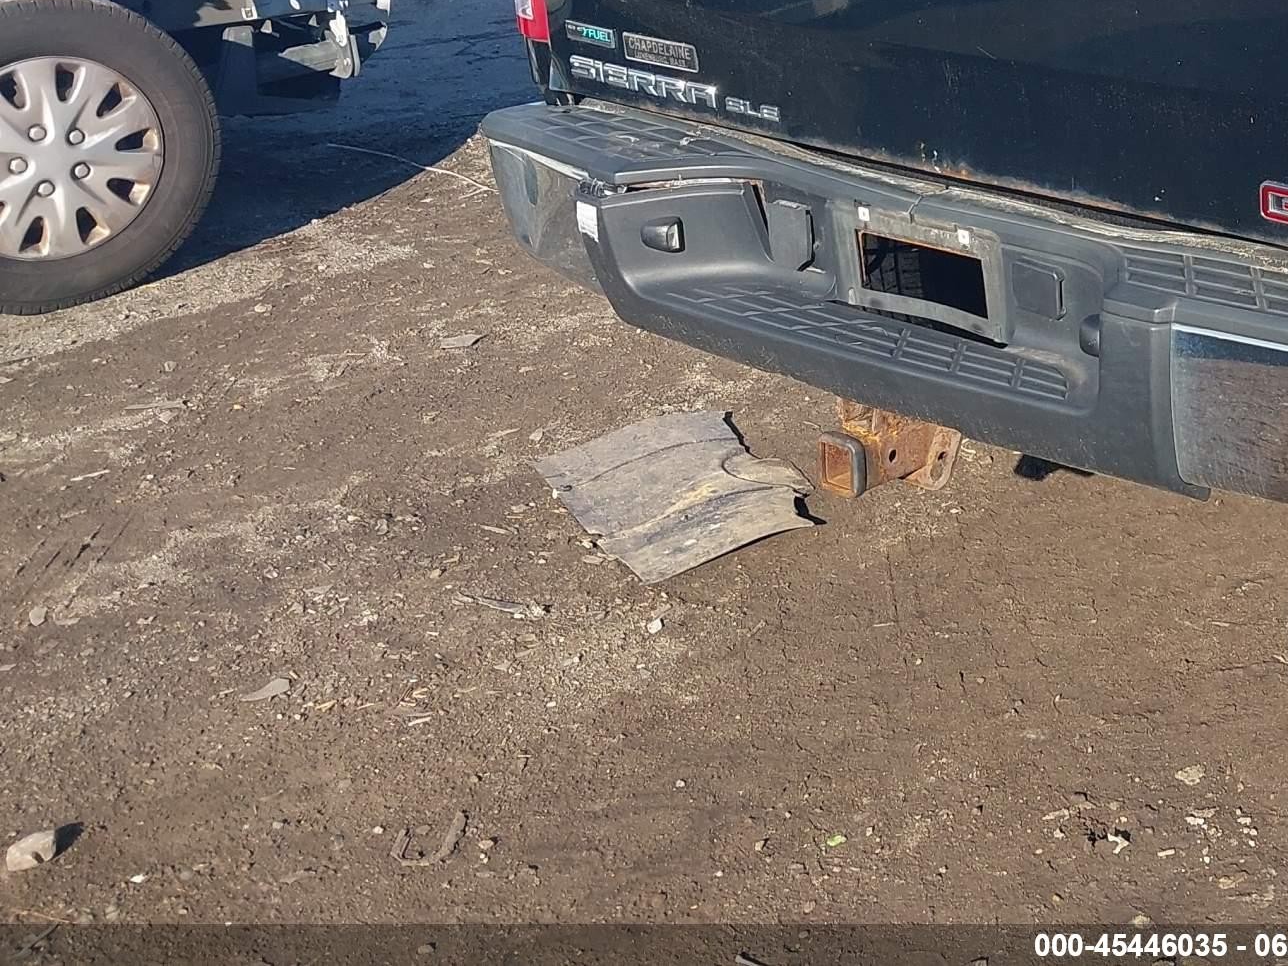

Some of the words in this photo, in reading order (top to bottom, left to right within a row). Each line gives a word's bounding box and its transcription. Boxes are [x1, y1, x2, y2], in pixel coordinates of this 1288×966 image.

[628, 37, 692, 61] CHAPDELAINE
[569, 55, 718, 109] SIERRA
[724, 96, 782, 122] SLE
